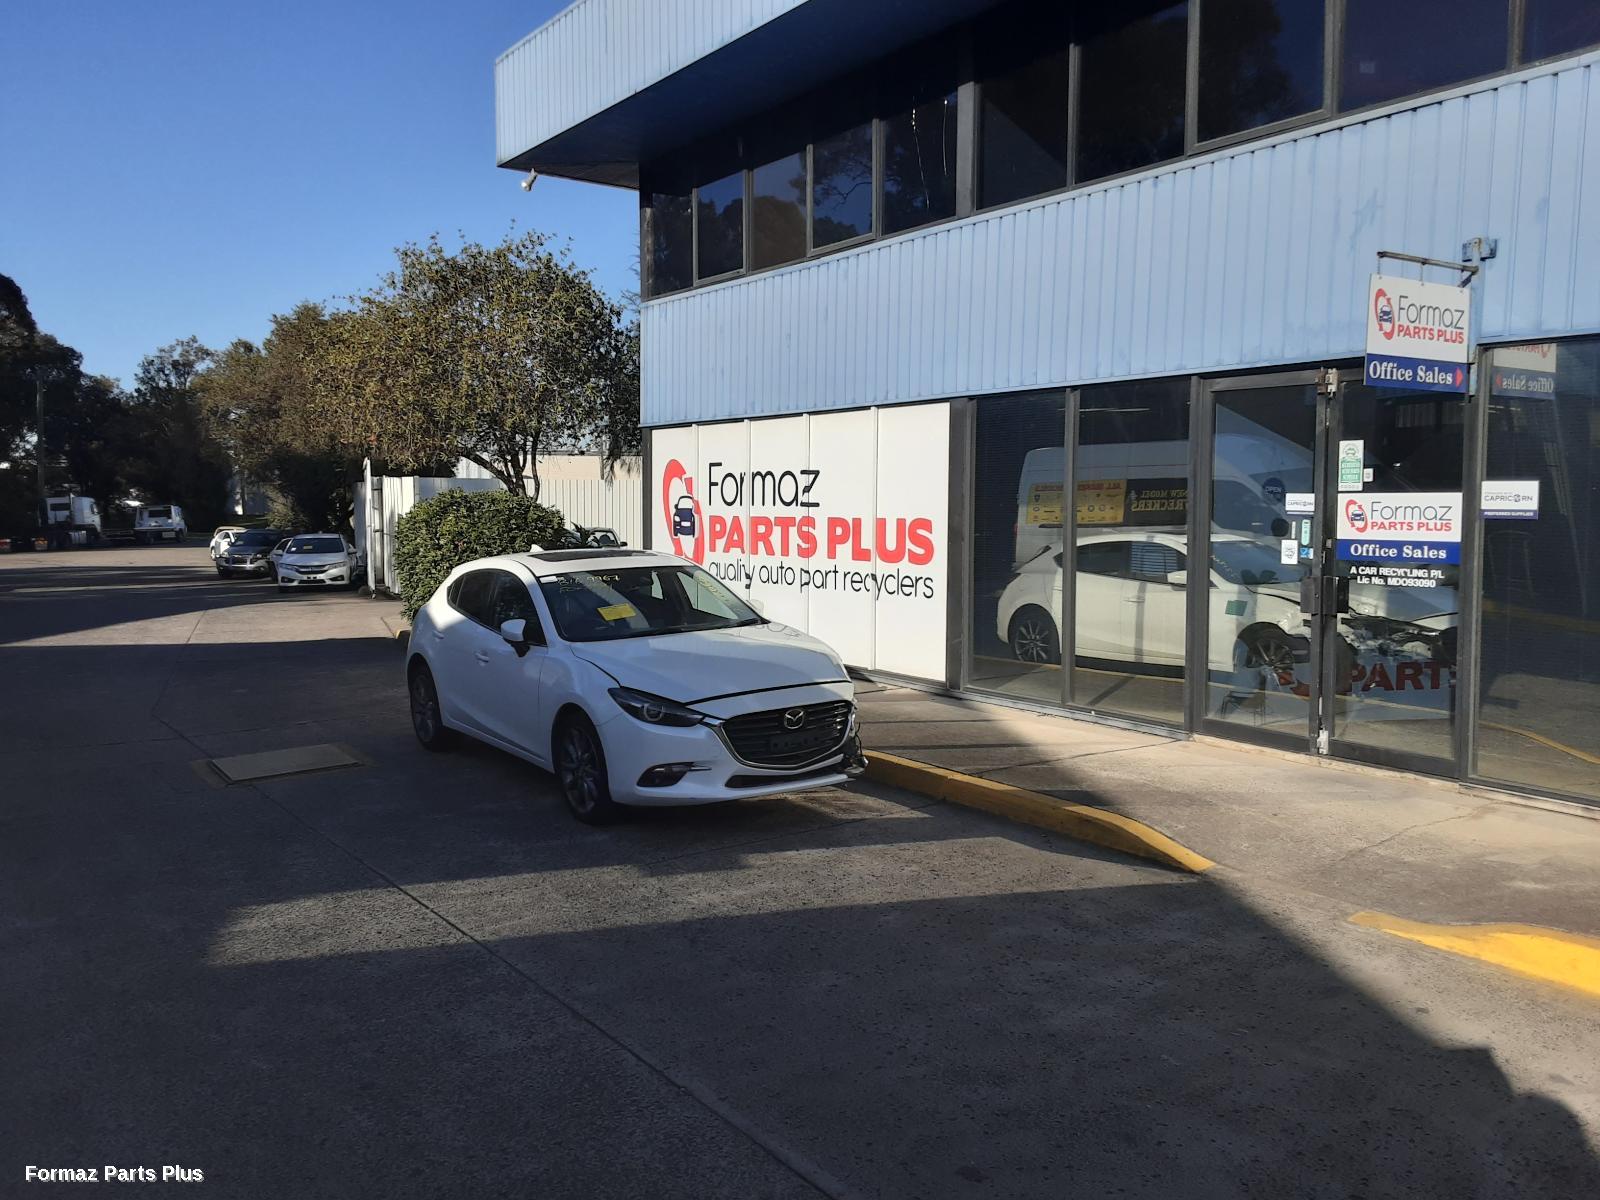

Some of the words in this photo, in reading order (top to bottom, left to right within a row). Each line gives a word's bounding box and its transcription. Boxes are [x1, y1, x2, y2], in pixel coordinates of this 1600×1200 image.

[1397, 295, 1465, 330] Formaz
[1397, 324, 1435, 341] PARTS
[1437, 328, 1465, 345] PLUS
[1369, 361, 1413, 382] Office
[1417, 365, 1453, 385] Sales
[709, 462, 820, 507] Formaz
[1371, 501, 1452, 521] Formaz
[1371, 521, 1414, 531] PARTS
[1417, 522, 1452, 531] PLUS
[709, 515, 818, 558] PARTS
[827, 517, 935, 565] PLUS
[1350, 543, 1397, 557] Office
[1402, 545, 1447, 559] Sales
[709, 558, 756, 590] qualiy
[759, 561, 796, 587] auto
[800, 564, 839, 593] part
[844, 568, 934, 600] recyclers
[1350, 566, 1357, 574] A
[1358, 566, 1377, 575] CAR
[1379, 567, 1428, 578] RECYCLING
[1430, 569, 1445, 579] P/L
[1357, 576, 1370, 584] Lic
[1371, 576, 1386, 585] No.
